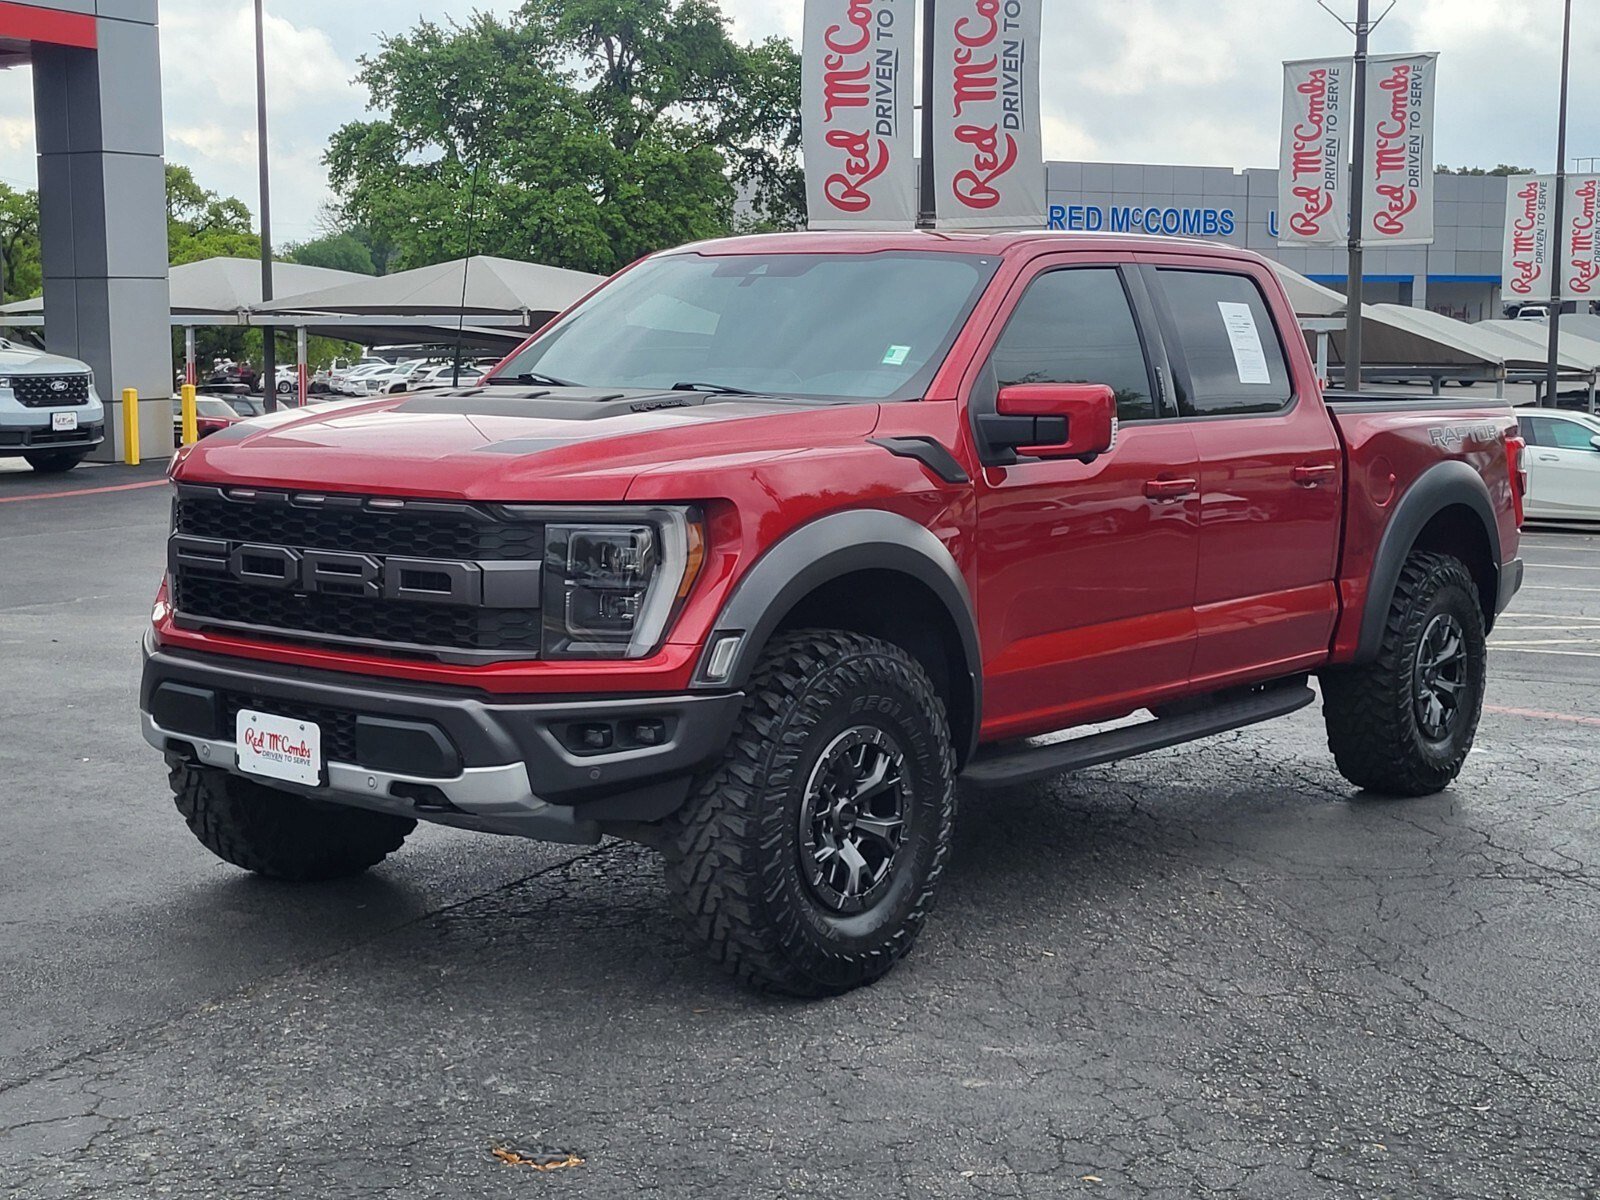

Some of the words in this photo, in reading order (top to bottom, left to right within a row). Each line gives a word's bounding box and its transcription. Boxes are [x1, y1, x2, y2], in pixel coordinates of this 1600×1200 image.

[877, 9, 894, 40] TO
[1004, 0, 1021, 32] TO
[876, 48, 893, 136] DRIVEN
[1003, 40, 1019, 130] DRIVEN
[1327, 68, 1340, 111] SERVE
[1411, 65, 1423, 107] SERVE
[1292, 69, 1326, 182] McCombs
[1326, 115, 1337, 134] TO
[1375, 65, 1410, 180] McCombs
[1410, 111, 1421, 130] TO
[824, 129, 889, 212] Red
[953, 123, 1017, 209] Red
[1325, 138, 1336, 190] DRIVEN
[1409, 135, 1420, 187] DRIVEN
[1290, 186, 1332, 236] Red
[1374, 184, 1417, 235] Red
[1538, 181, 1547, 210] SERVE
[1050, 205, 1102, 231] RED
[1512, 182, 1538, 258] McCombs
[1537, 214, 1545, 228] TO
[1571, 180, 1597, 257] McCombs
[1536, 229, 1544, 264] DRIVEN
[1510, 260, 1541, 294] Red
[1569, 260, 1600, 293] Red
[168, 533, 482, 607] FORD
[245, 727, 264, 754] Red
[266, 733, 310, 758] McCombs
[262, 751, 283, 760] DRIVEN
[284, 755, 293, 763] TO
[293, 757, 311, 767] SERVE
